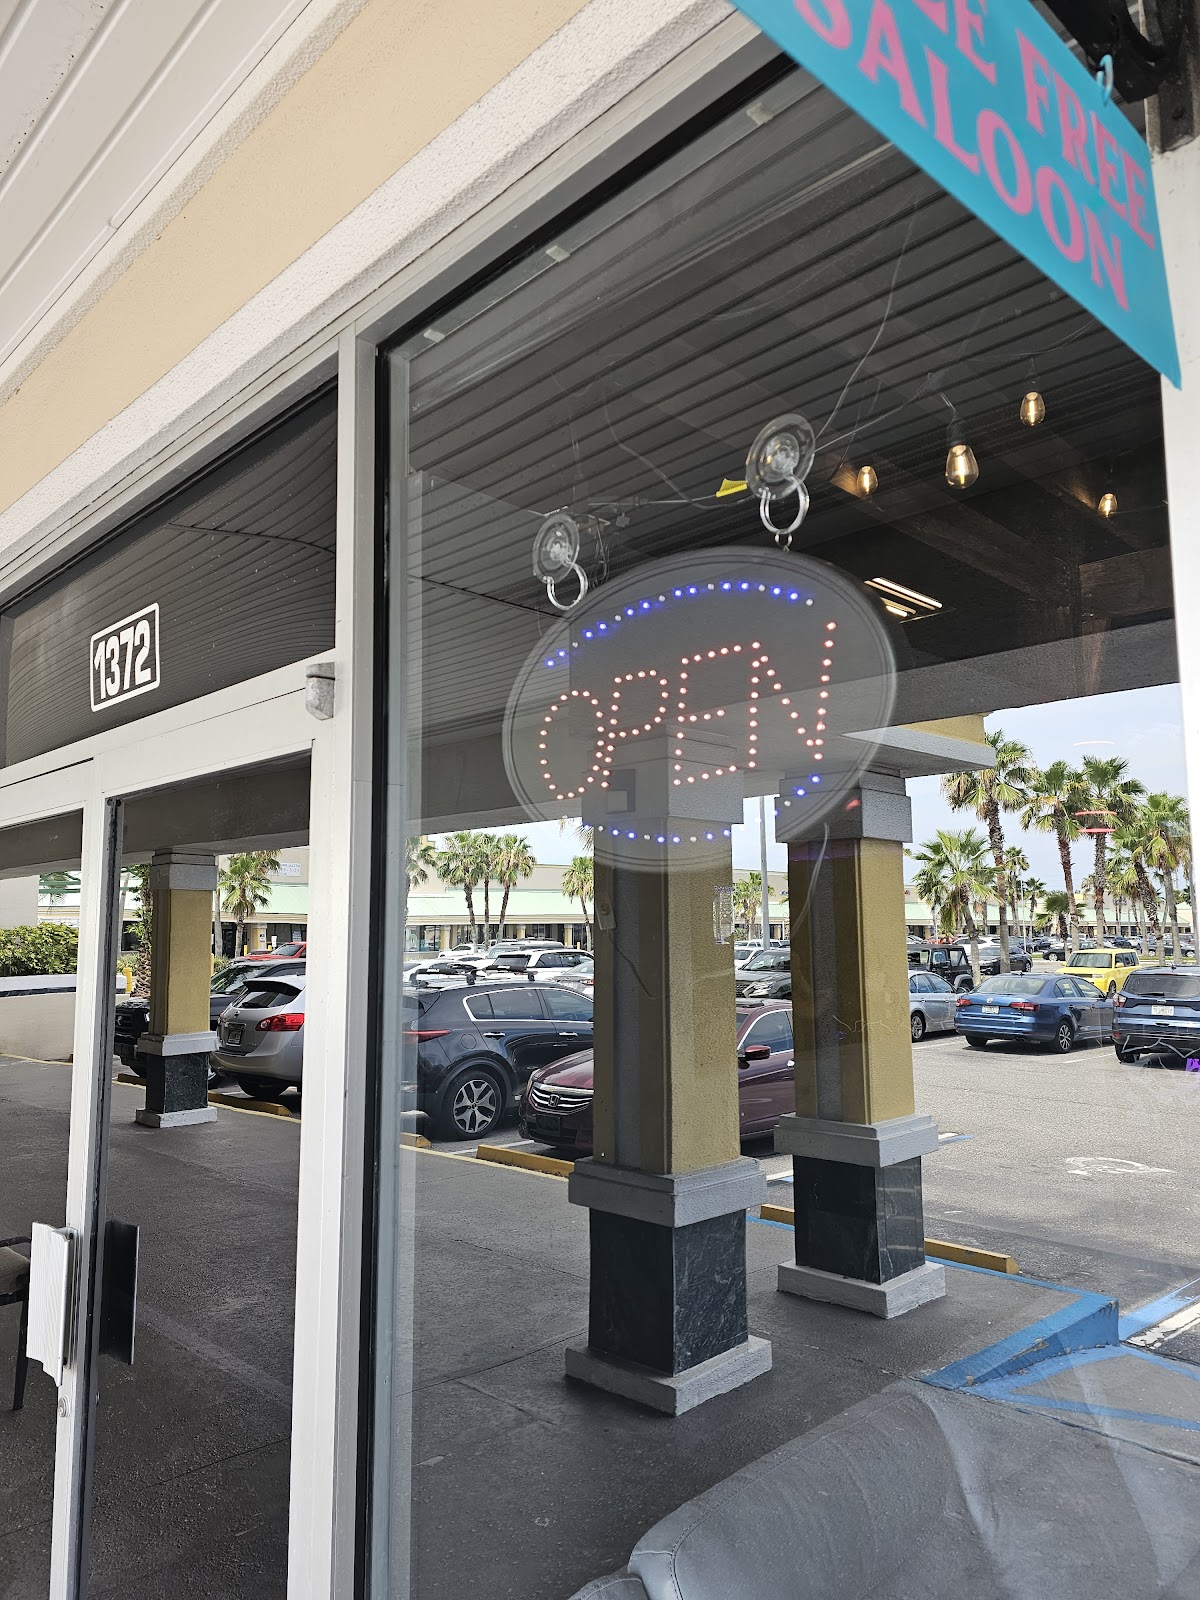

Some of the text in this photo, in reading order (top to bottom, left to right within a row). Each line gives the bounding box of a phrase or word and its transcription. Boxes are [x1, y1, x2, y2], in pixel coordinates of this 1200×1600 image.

[1015, 29, 1155, 249] FREE
[93, 619, 152, 700] 1372
[538, 621, 837, 800] OPEN
